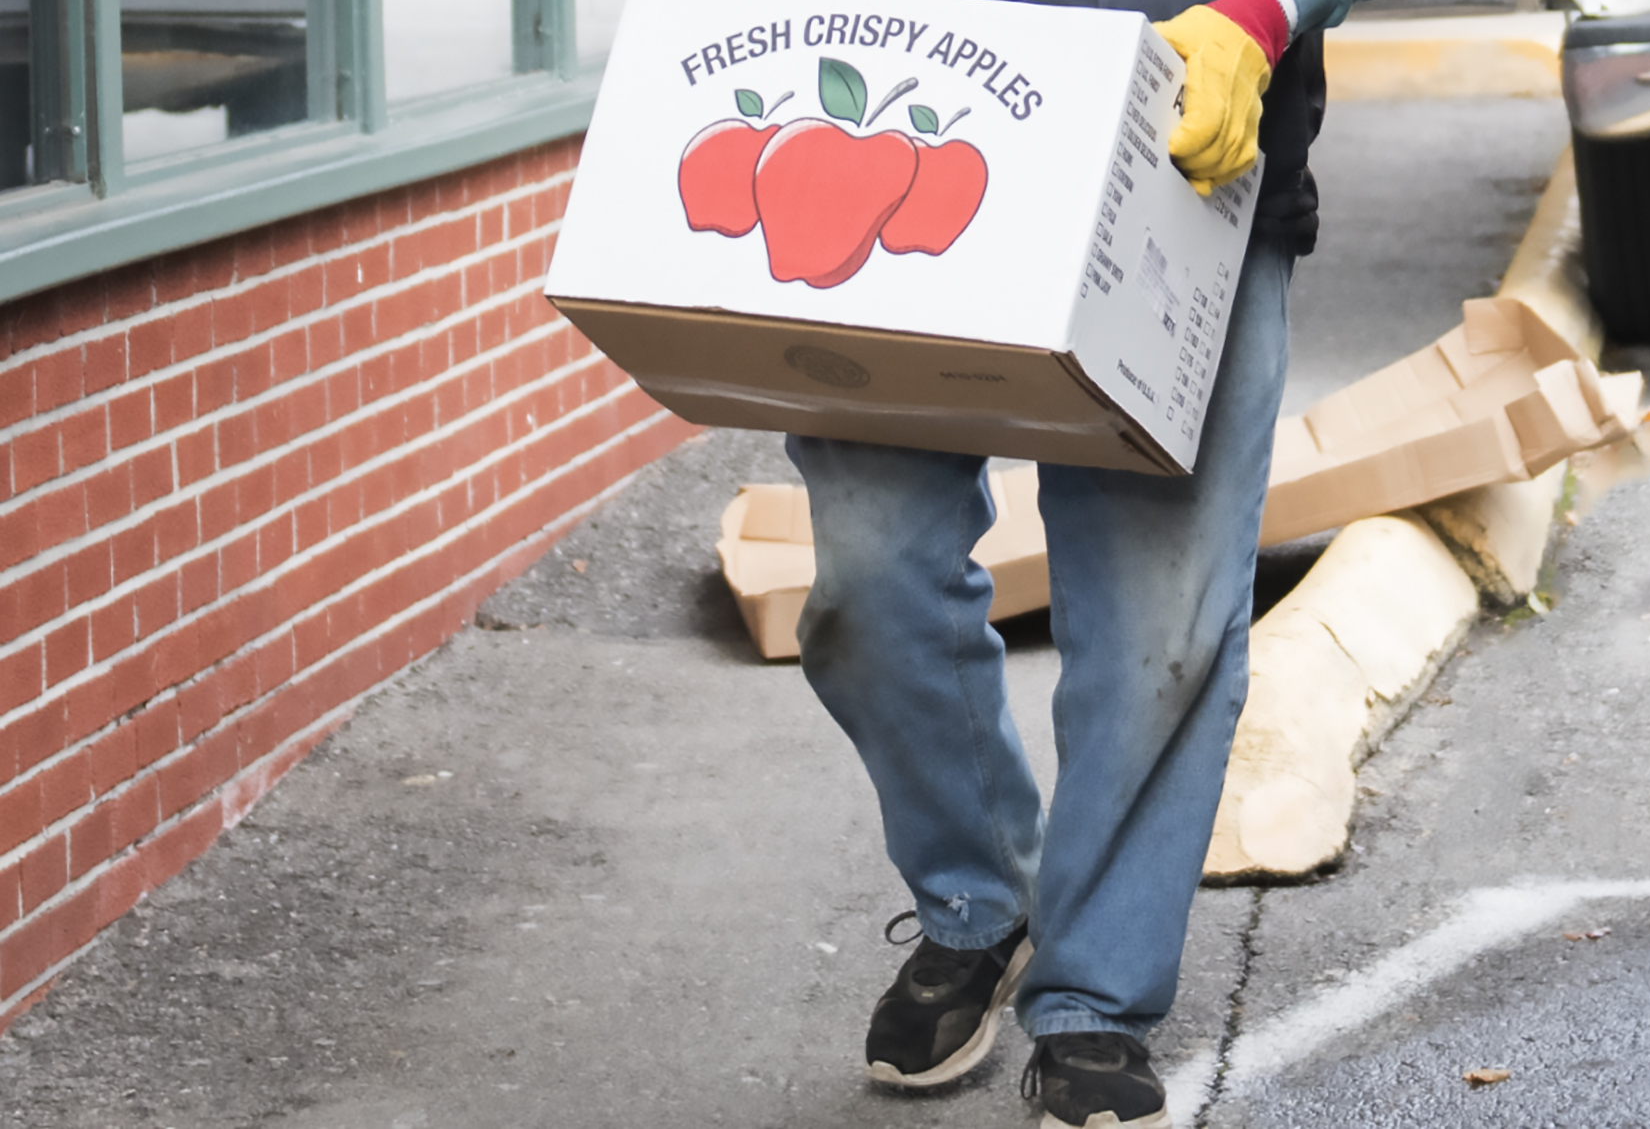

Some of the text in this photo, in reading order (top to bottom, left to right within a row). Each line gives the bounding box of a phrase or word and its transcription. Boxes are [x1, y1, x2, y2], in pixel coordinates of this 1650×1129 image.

[680, 14, 1043, 121] FRESH CRISPY APPLES
